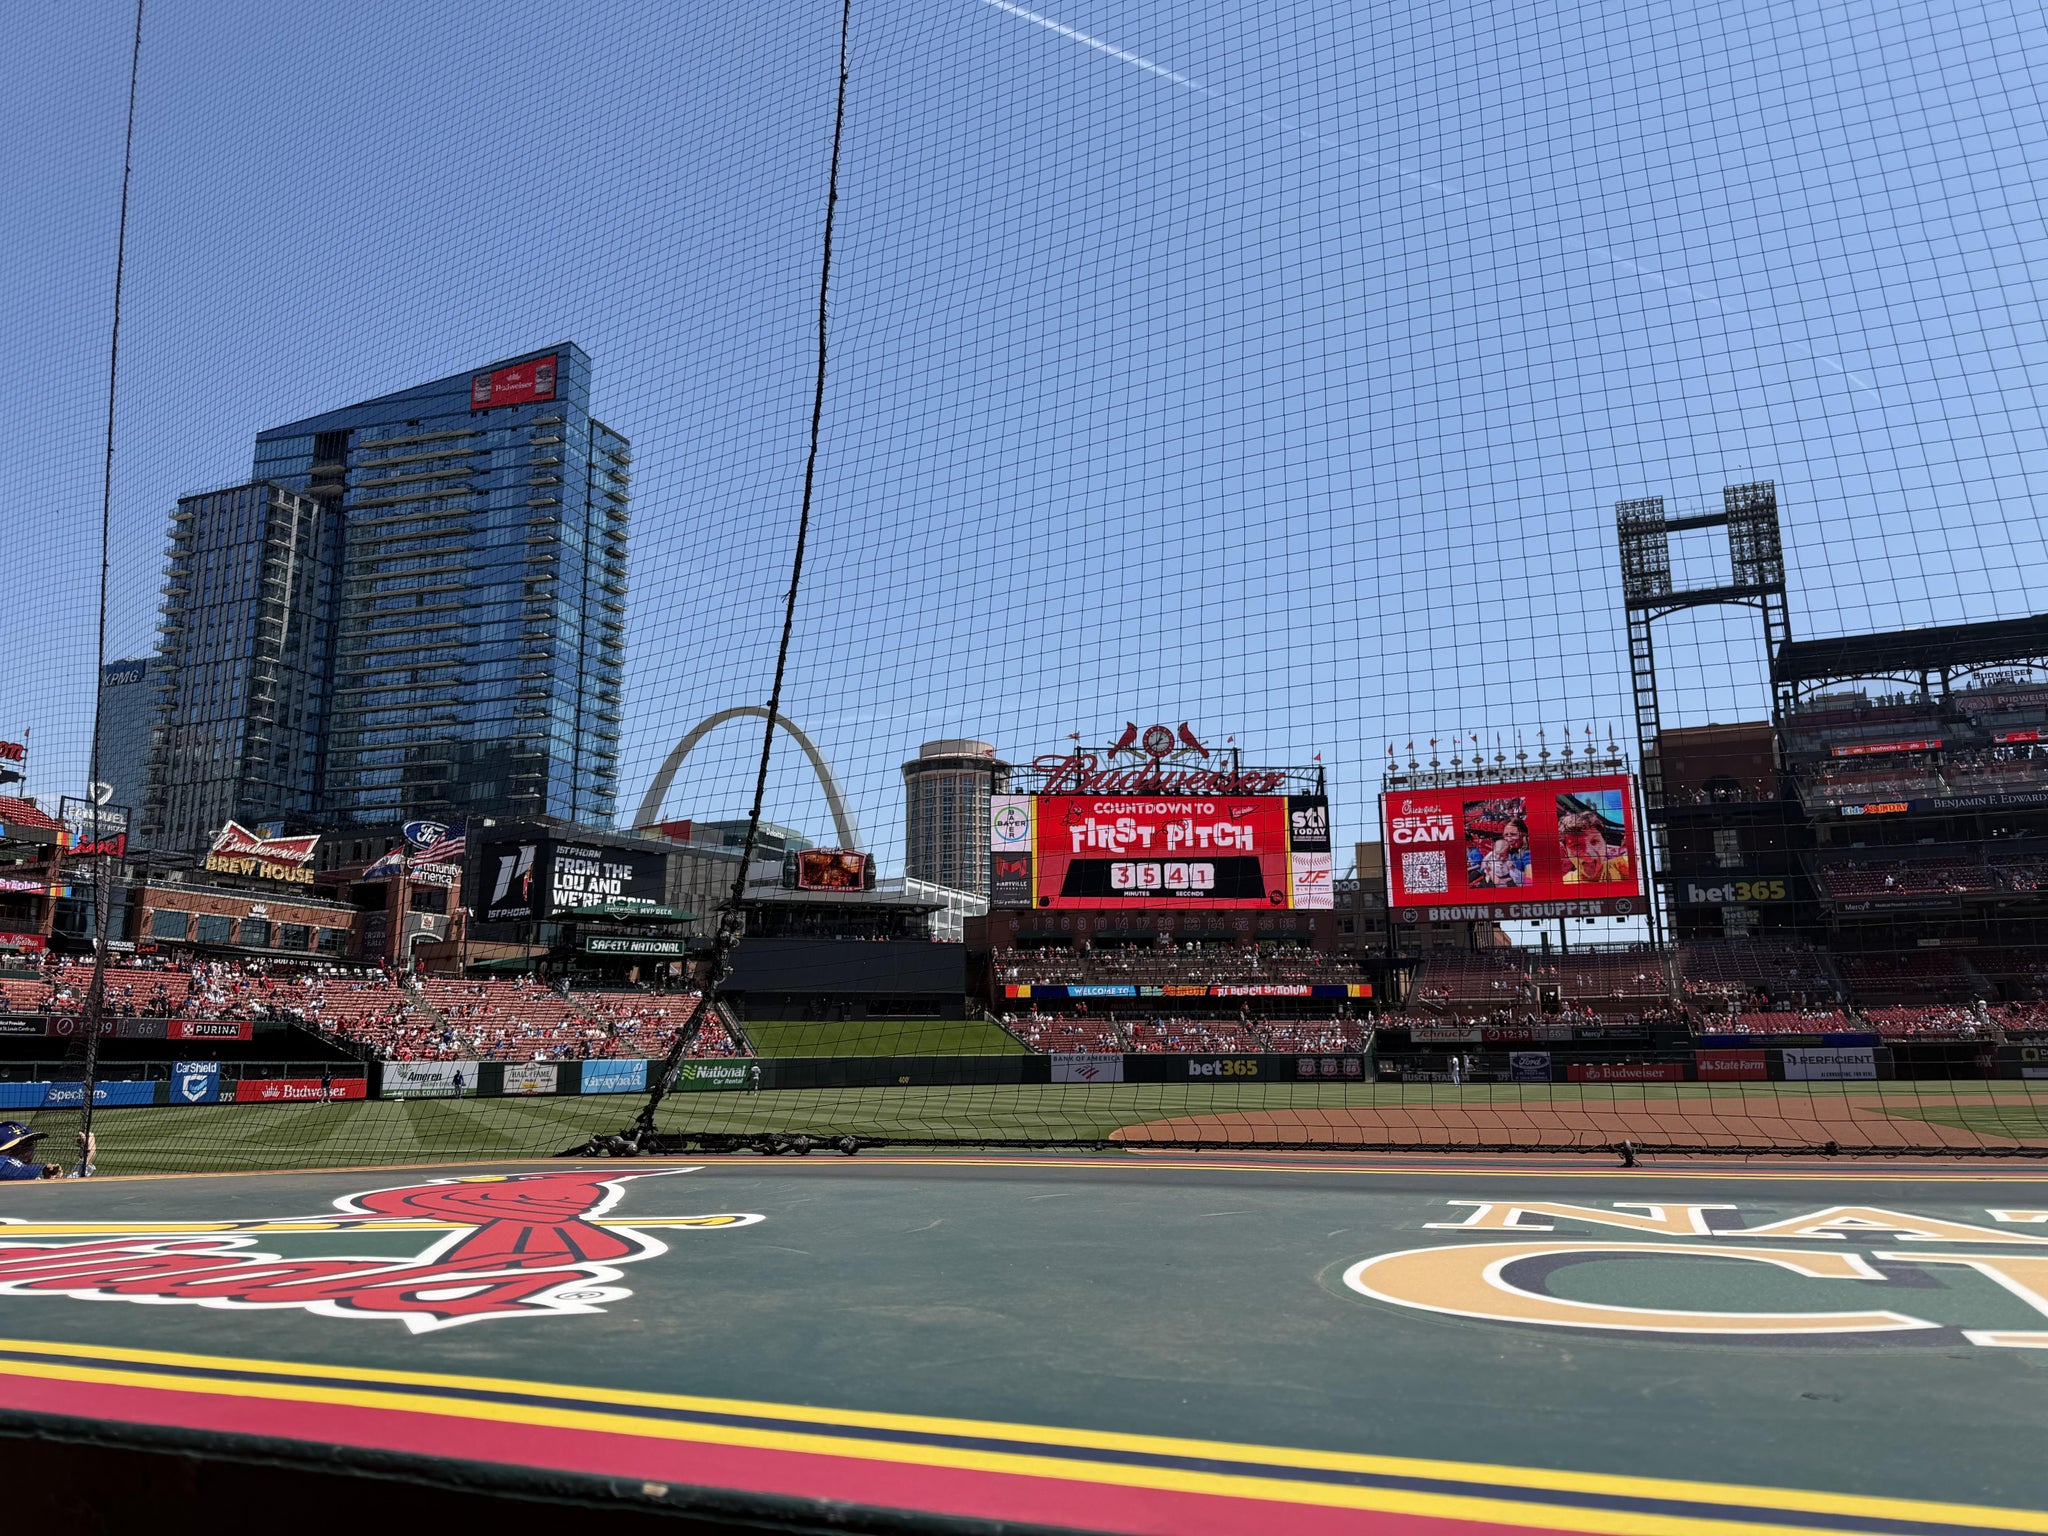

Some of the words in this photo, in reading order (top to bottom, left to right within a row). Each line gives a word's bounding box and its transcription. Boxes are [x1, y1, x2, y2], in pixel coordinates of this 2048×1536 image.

[103, 670, 139, 686] KPMG
[1034, 754, 1285, 794] Budweiser
[1406, 770, 1477, 787] WORLD
[1093, 802, 1193, 815] COUNTDOWN
[1194, 802, 1215, 814] TO
[1934, 795, 1987, 809] BENJAMIN
[1990, 795, 1998, 804] F.
[1392, 815, 1453, 829] SELFIE
[1070, 817, 1155, 854] FIRST
[1167, 819, 1253, 851] PITCH
[1393, 825, 1455, 844] CAM
[204, 831, 315, 863] Budweiser
[206, 853, 257, 875] BREW
[260, 862, 315, 884] HOUSE
[554, 857, 600, 877] FROM
[603, 863, 633, 880] THE
[553, 873, 585, 891] LOU
[588, 877, 621, 895] AND
[1688, 880, 1786, 903] bet365
[1428, 904, 1490, 921] BROWN
[1494, 907, 1504, 919] &
[1508, 899, 1603, 918] CROUPPEN
[1845, 903, 1865, 912] Mercy
[592, 940, 629, 950] SAFETY
[630, 941, 679, 952] NATIONAL
[1074, 987, 1117, 996] WELCOME
[1118, 987, 1128, 995] TO
[195, 1024, 238, 1036] PURINA
[1502, 1030, 1529, 1039] 12:39
[176, 1062, 217, 1074] CarShield
[1188, 1059, 1258, 1077] bet365
[1519, 1057, 1542, 1066] Ford
[1714, 1060, 1740, 1071] State
[1740, 1060, 1764, 1071] Farm
[407, 1071, 442, 1083] Ameren
[511, 1070, 529, 1078] HALL
[696, 1064, 747, 1079] National
[1402, 1073, 1430, 1082] BUSCH
[1603, 1067, 1665, 1079] Budweiser
[219, 1092, 235, 1102] 375'
